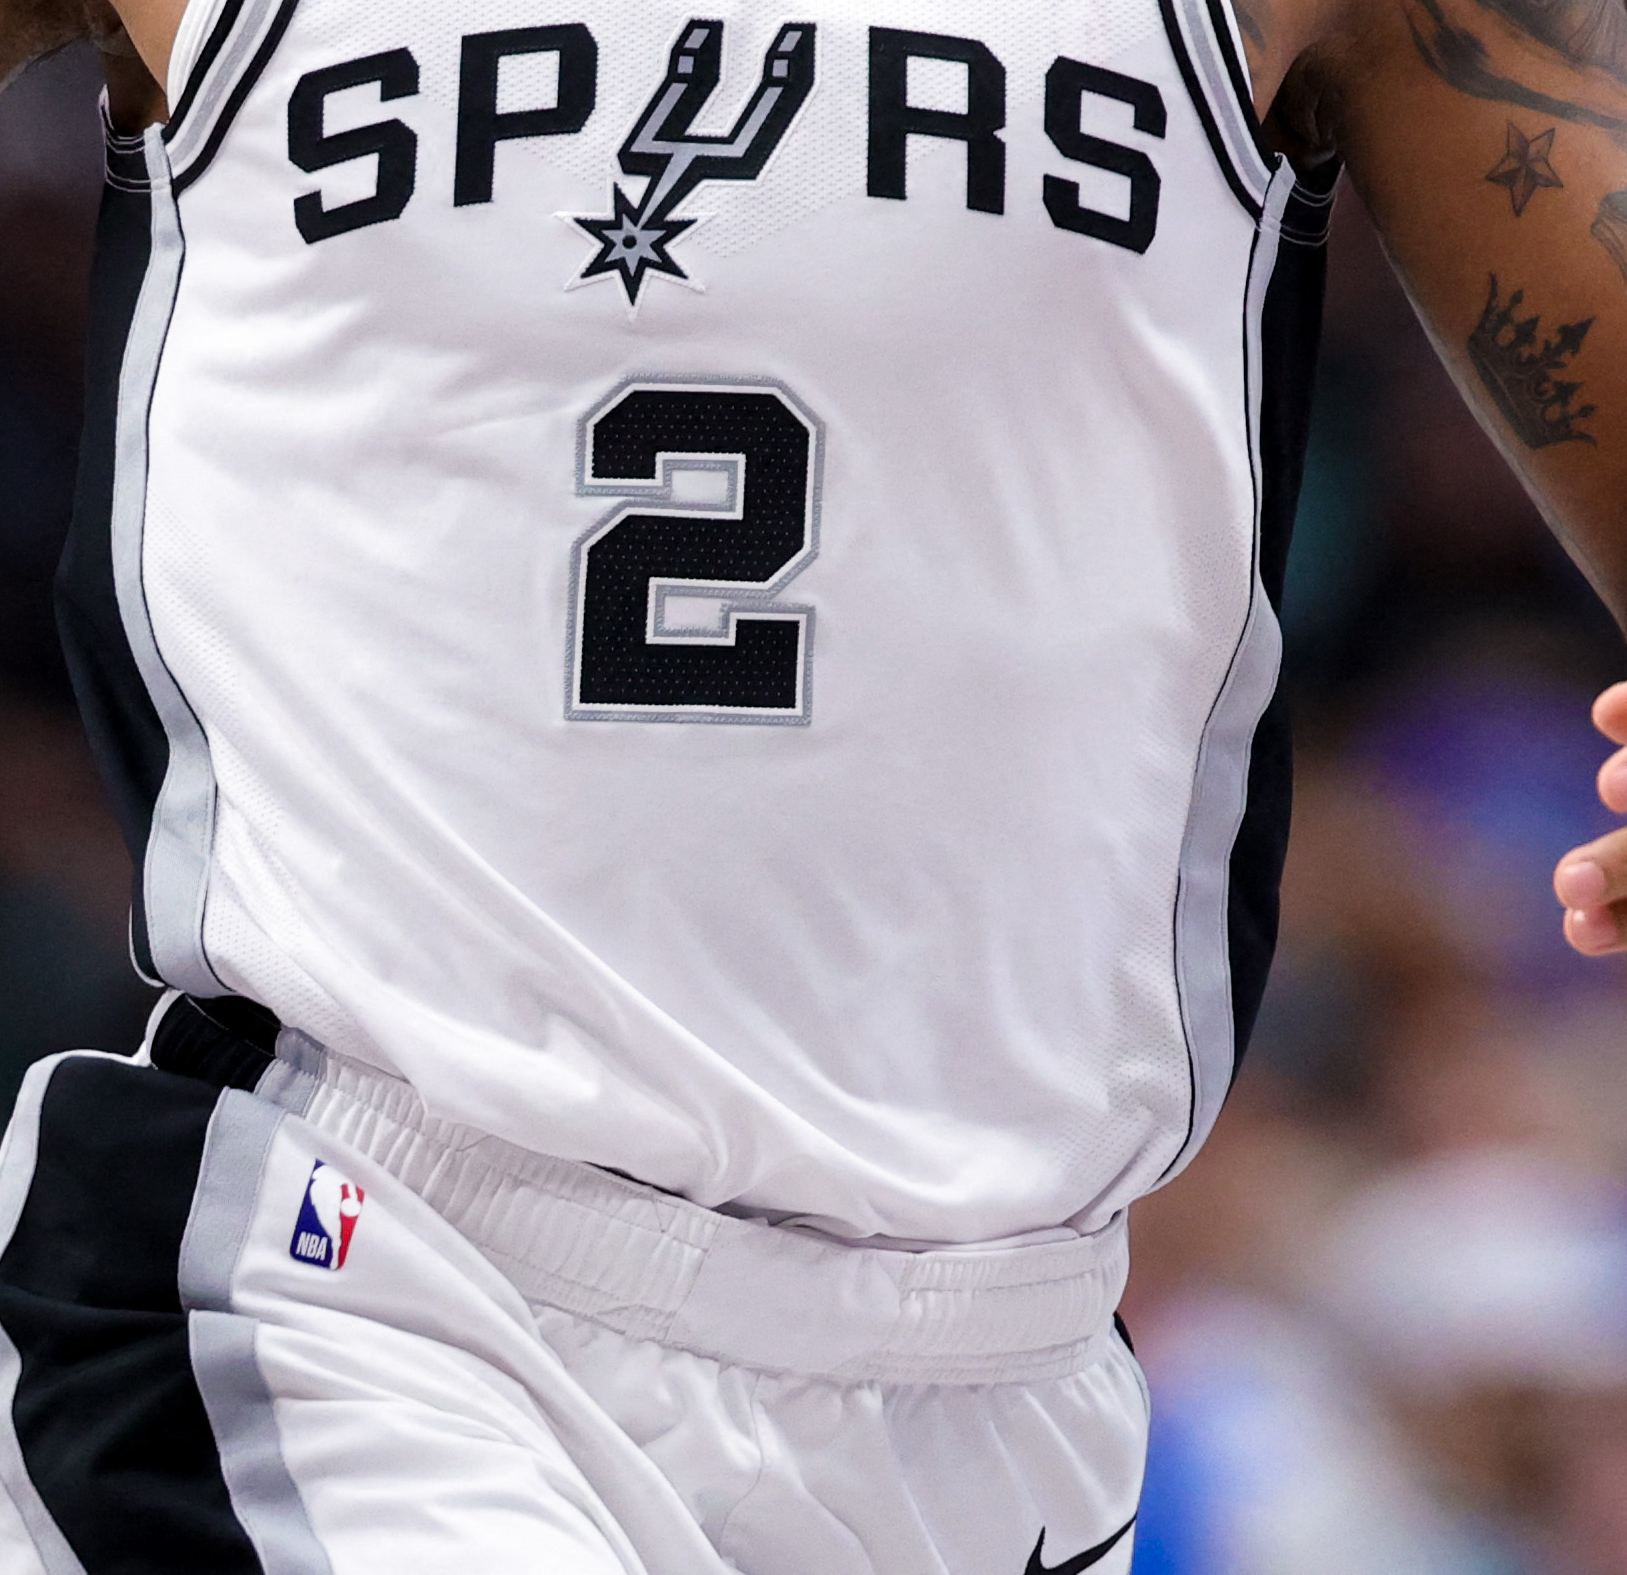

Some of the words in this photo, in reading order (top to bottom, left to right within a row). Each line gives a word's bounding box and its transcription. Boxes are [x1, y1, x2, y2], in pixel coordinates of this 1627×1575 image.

[287, 18, 1168, 308] SPURS
[564, 373, 826, 726] 2
[295, 1230, 329, 1261] NBA
